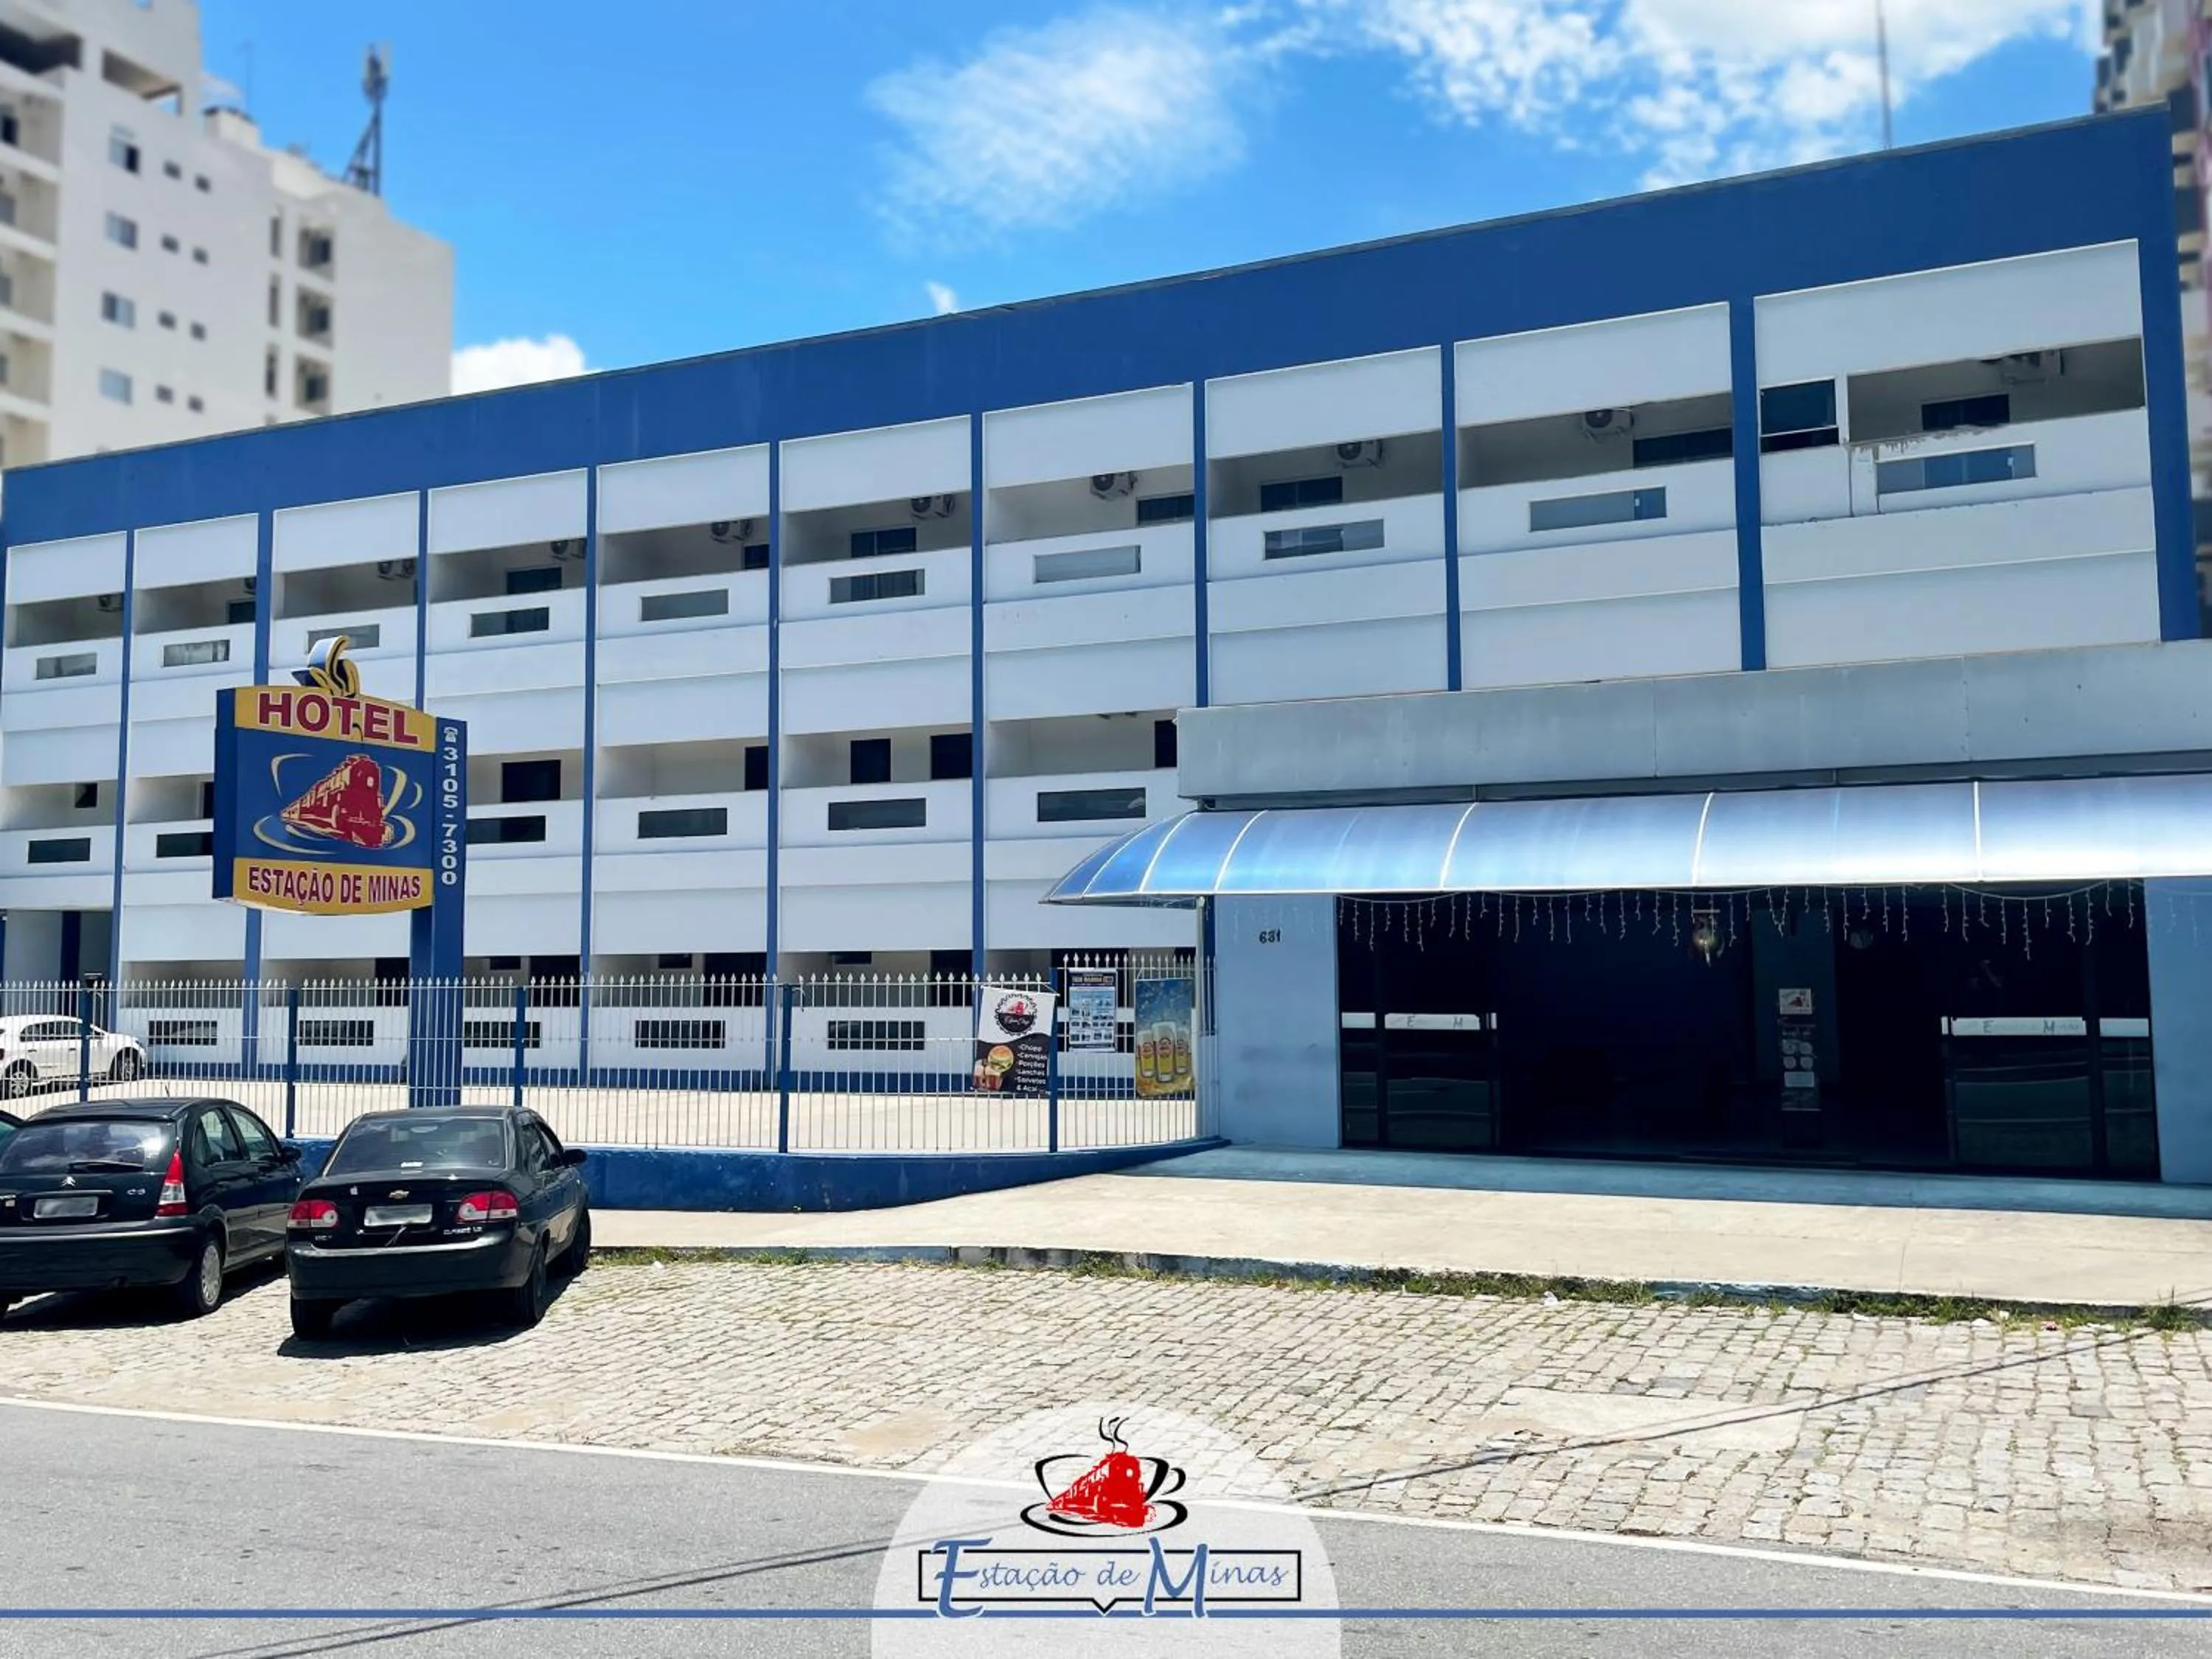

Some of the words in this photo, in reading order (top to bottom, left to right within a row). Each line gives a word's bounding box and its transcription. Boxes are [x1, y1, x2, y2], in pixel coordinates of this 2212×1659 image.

[258, 692, 419, 745] HOTEL
[442, 747, 459, 886] 3105-7300
[248, 866, 335, 906] ESTAÇÃO
[340, 872, 363, 904] DE
[368, 874, 421, 904] MINAS
